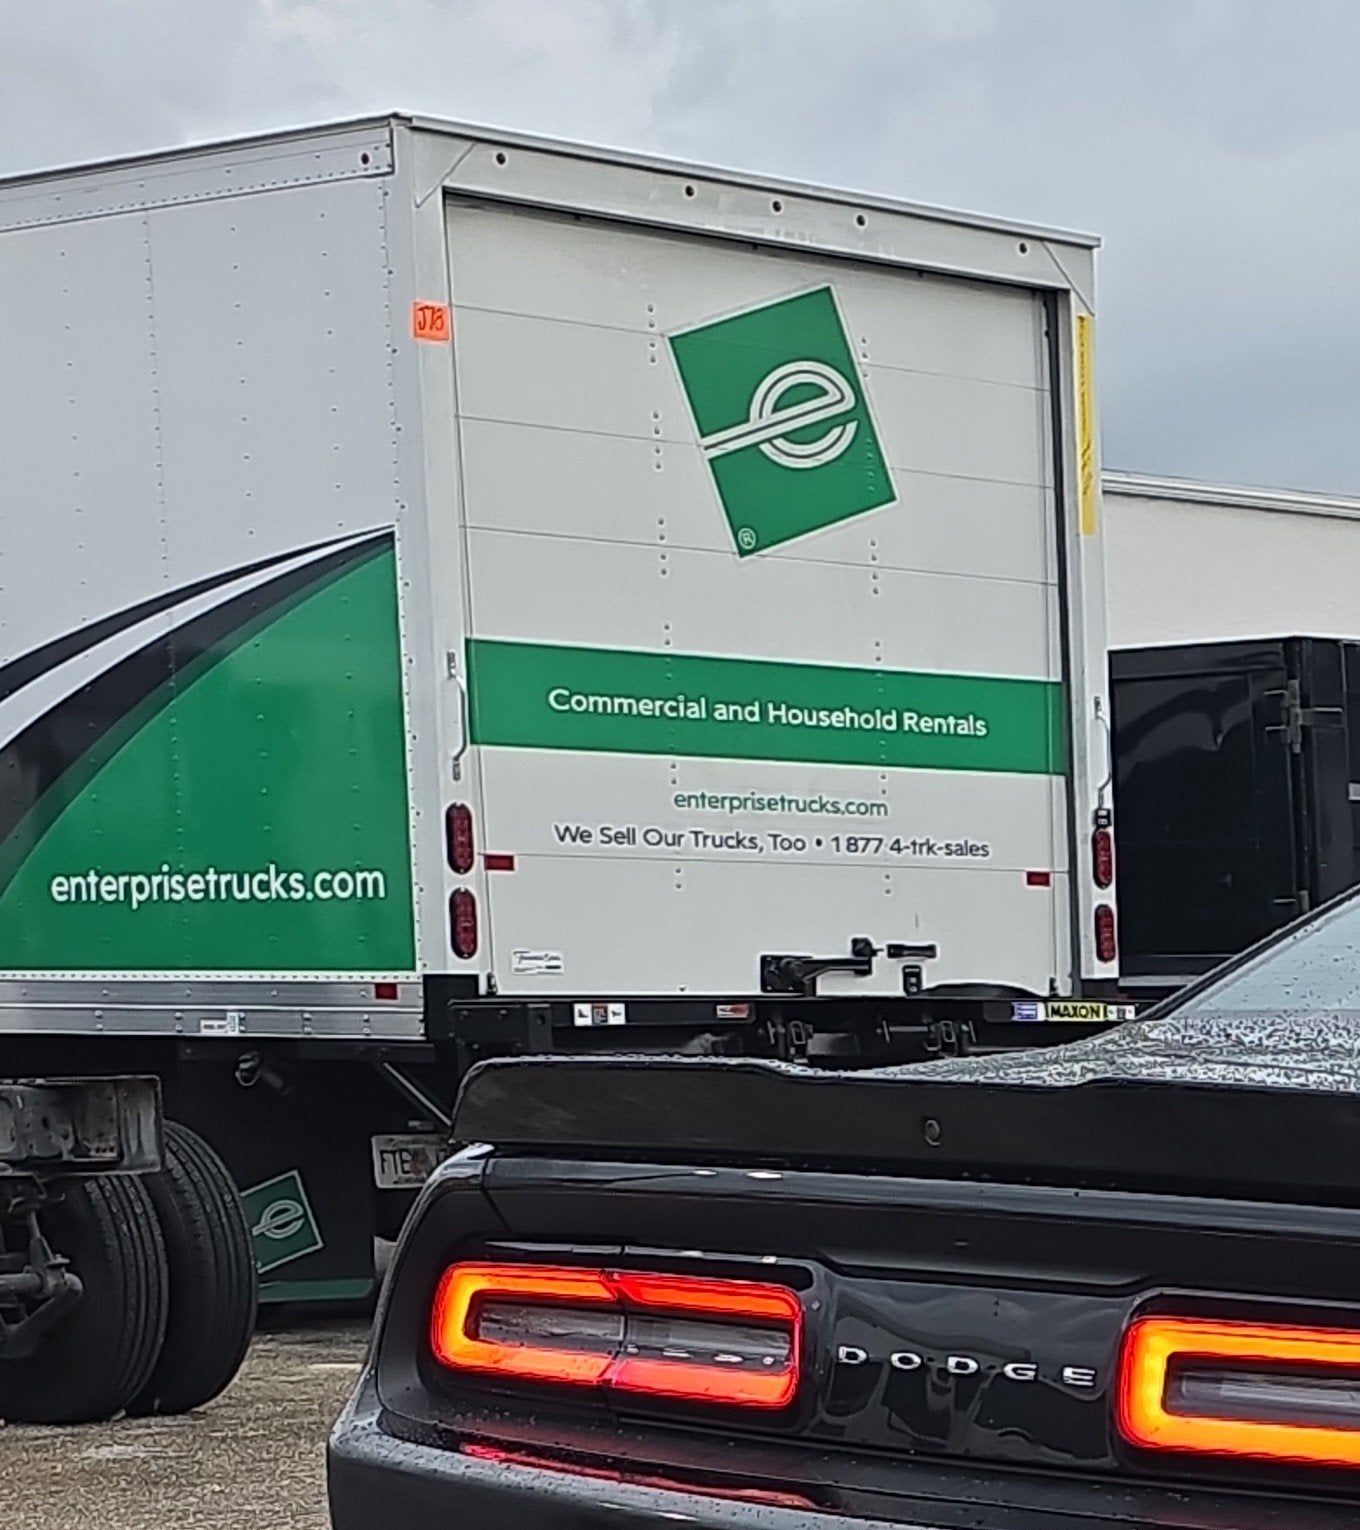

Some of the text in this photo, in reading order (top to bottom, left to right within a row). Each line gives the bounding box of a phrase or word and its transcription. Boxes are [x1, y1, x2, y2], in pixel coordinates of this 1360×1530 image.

[548, 688, 988, 737] Commercial and Household Rentals
[674, 791, 889, 816] enterprisetrucks.com
[554, 824, 593, 844] We
[600, 826, 636, 846] Sell
[643, 828, 685, 848] Our
[689, 830, 764, 854] Trucks,
[767, 833, 806, 852] Too
[889, 837, 990, 858] 4-trk-sales
[51, 863, 386, 911] enterprisetrucks.com
[1050, 1004, 1101, 1019] MAXON
[837, 1345, 1097, 1387] DODGE
